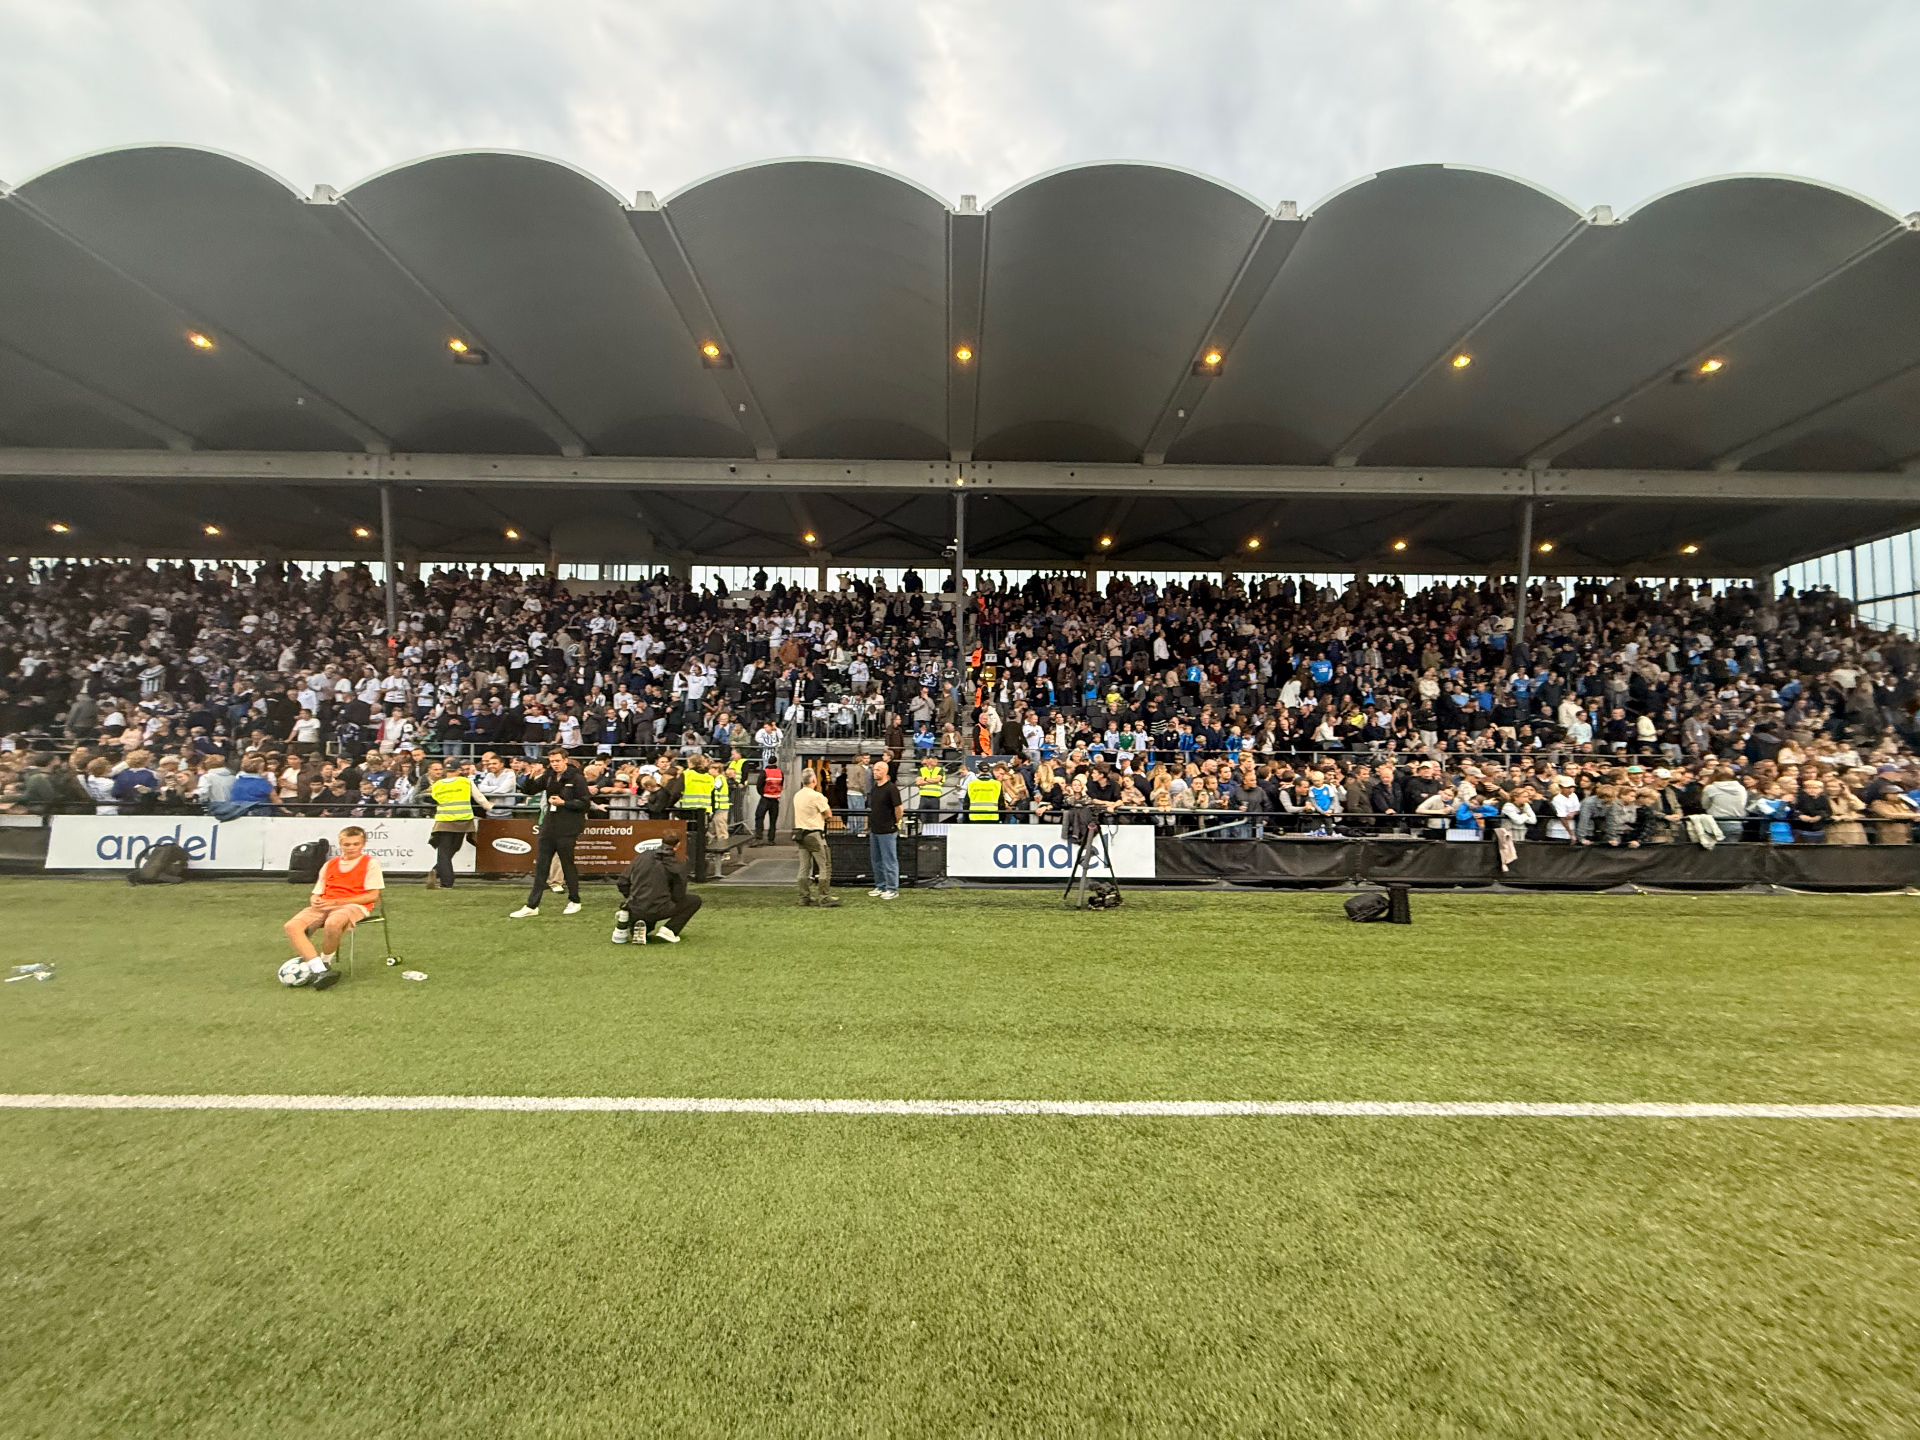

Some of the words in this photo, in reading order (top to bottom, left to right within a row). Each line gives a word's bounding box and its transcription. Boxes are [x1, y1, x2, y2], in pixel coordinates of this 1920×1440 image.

[365, 829, 389, 842] pirs
[580, 825, 633, 836] mørrebrød
[328, 845, 414, 857] Tøerservice
